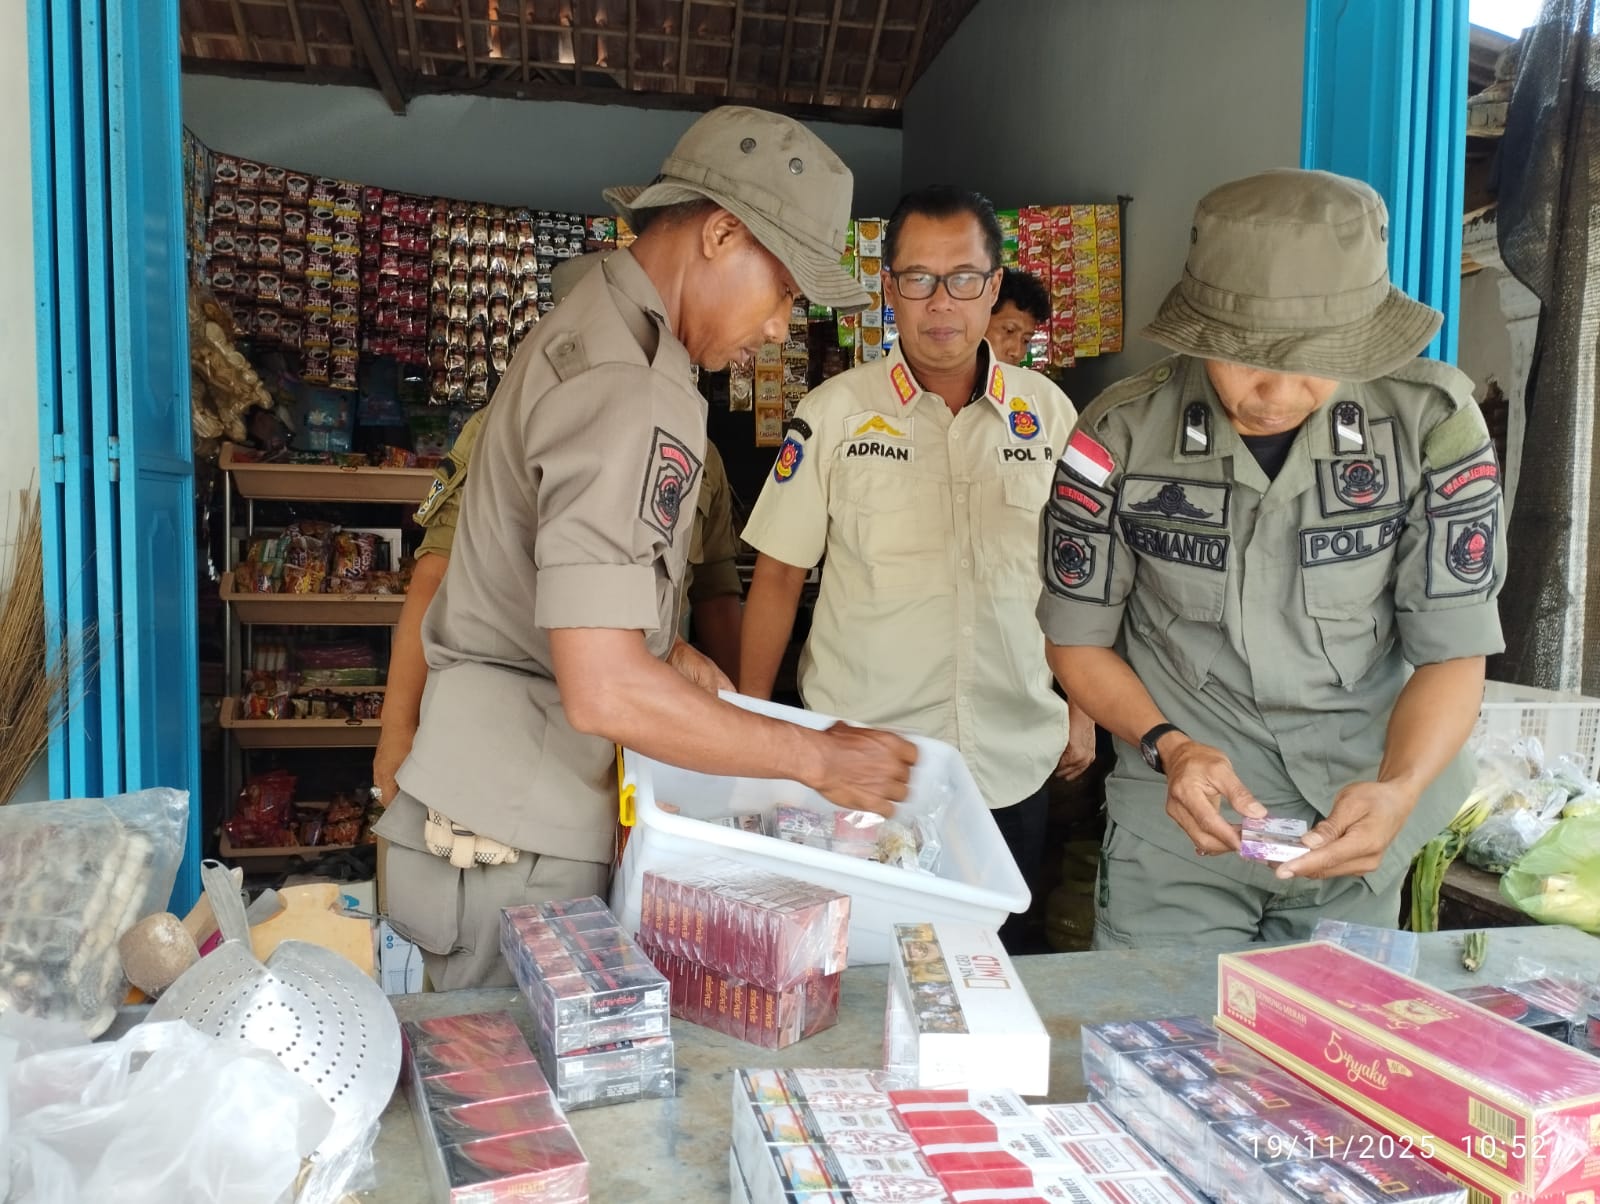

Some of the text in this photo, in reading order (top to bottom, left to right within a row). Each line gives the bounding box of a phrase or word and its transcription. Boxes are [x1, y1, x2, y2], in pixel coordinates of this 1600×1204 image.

[336, 216, 358, 224] ABC
[310, 228, 332, 236] ABC
[334, 321, 355, 329] ABC
[847, 442, 909, 461] ADRIAN
[1003, 448, 1036, 461] POL
[1310, 529, 1373, 559] POL
[971, 955, 1008, 979] MILD
